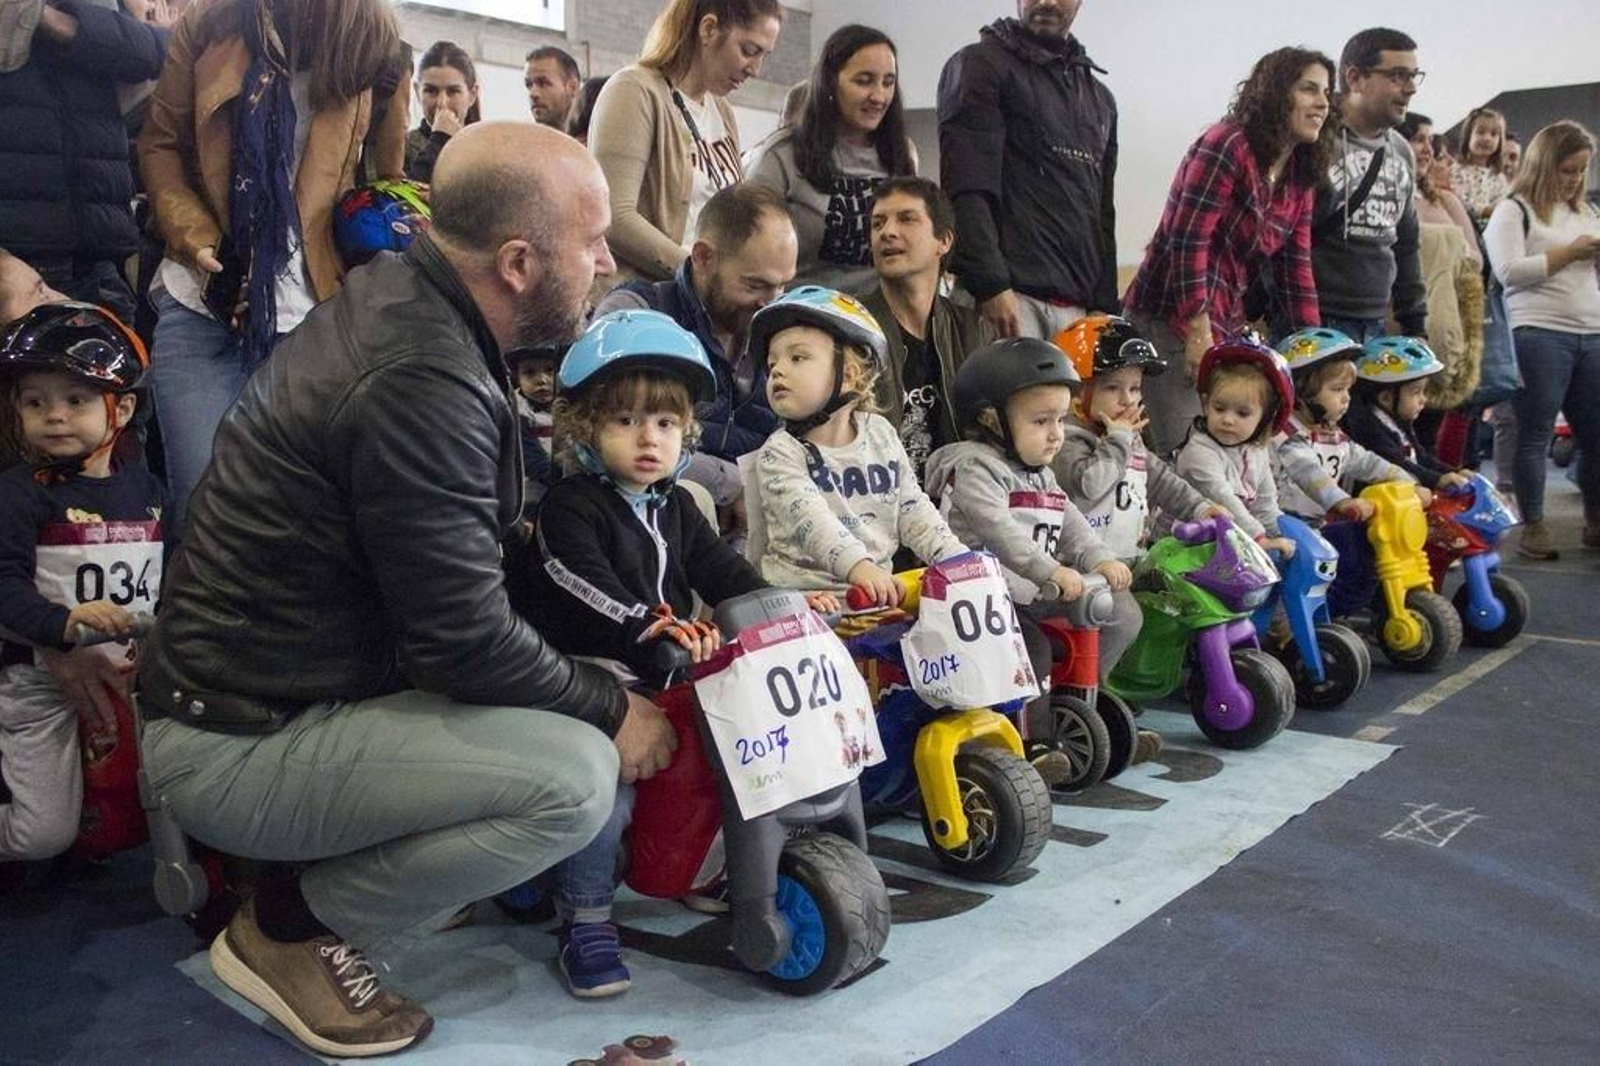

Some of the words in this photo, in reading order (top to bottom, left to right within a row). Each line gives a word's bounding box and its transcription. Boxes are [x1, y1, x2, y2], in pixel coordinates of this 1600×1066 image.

[75, 559, 152, 606] 034
[766, 653, 842, 718] 020
[918, 654, 960, 685] 2017
[735, 724, 789, 766] 2017
